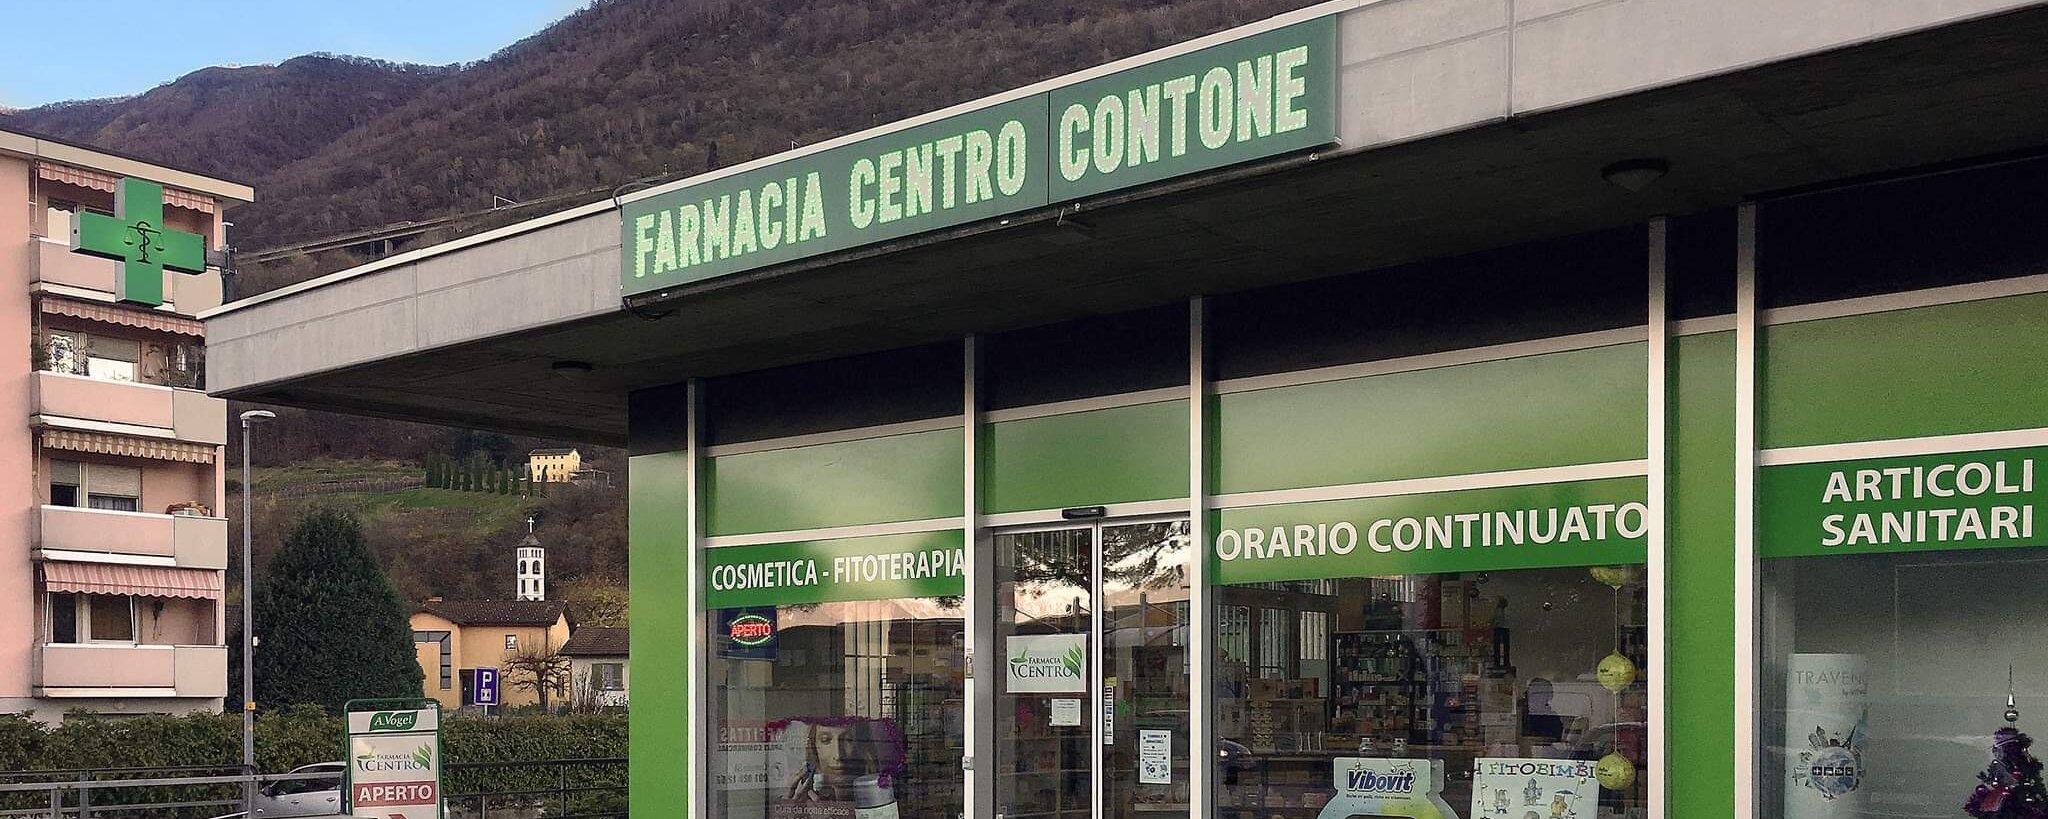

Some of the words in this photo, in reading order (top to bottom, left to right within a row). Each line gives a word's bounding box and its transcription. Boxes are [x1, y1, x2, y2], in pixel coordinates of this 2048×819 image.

[634, 171, 828, 279] FARMACIA
[849, 120, 1028, 230] CENTRO
[1059, 45, 1310, 183] CONTONE
[1821, 459, 2033, 503] ARTICOLI
[1215, 521, 1358, 561] ORARIO
[1367, 502, 1648, 553] CONTINUATO
[1821, 505, 2033, 547] SANITARI
[711, 559, 818, 590] COSMETICA
[833, 548, 965, 584] FITOTERAPIA
[730, 621, 771, 638] APERTO
[482, 671, 492, 688] P
[1017, 664, 1073, 678] CENTRO
[374, 714, 413, 728] A.Vogel
[365, 760, 422, 772] CENTRO
[1488, 761, 1596, 778] FITOBIMBI
[1347, 769, 1415, 792] Vibovit
[358, 784, 433, 802] APERTO
